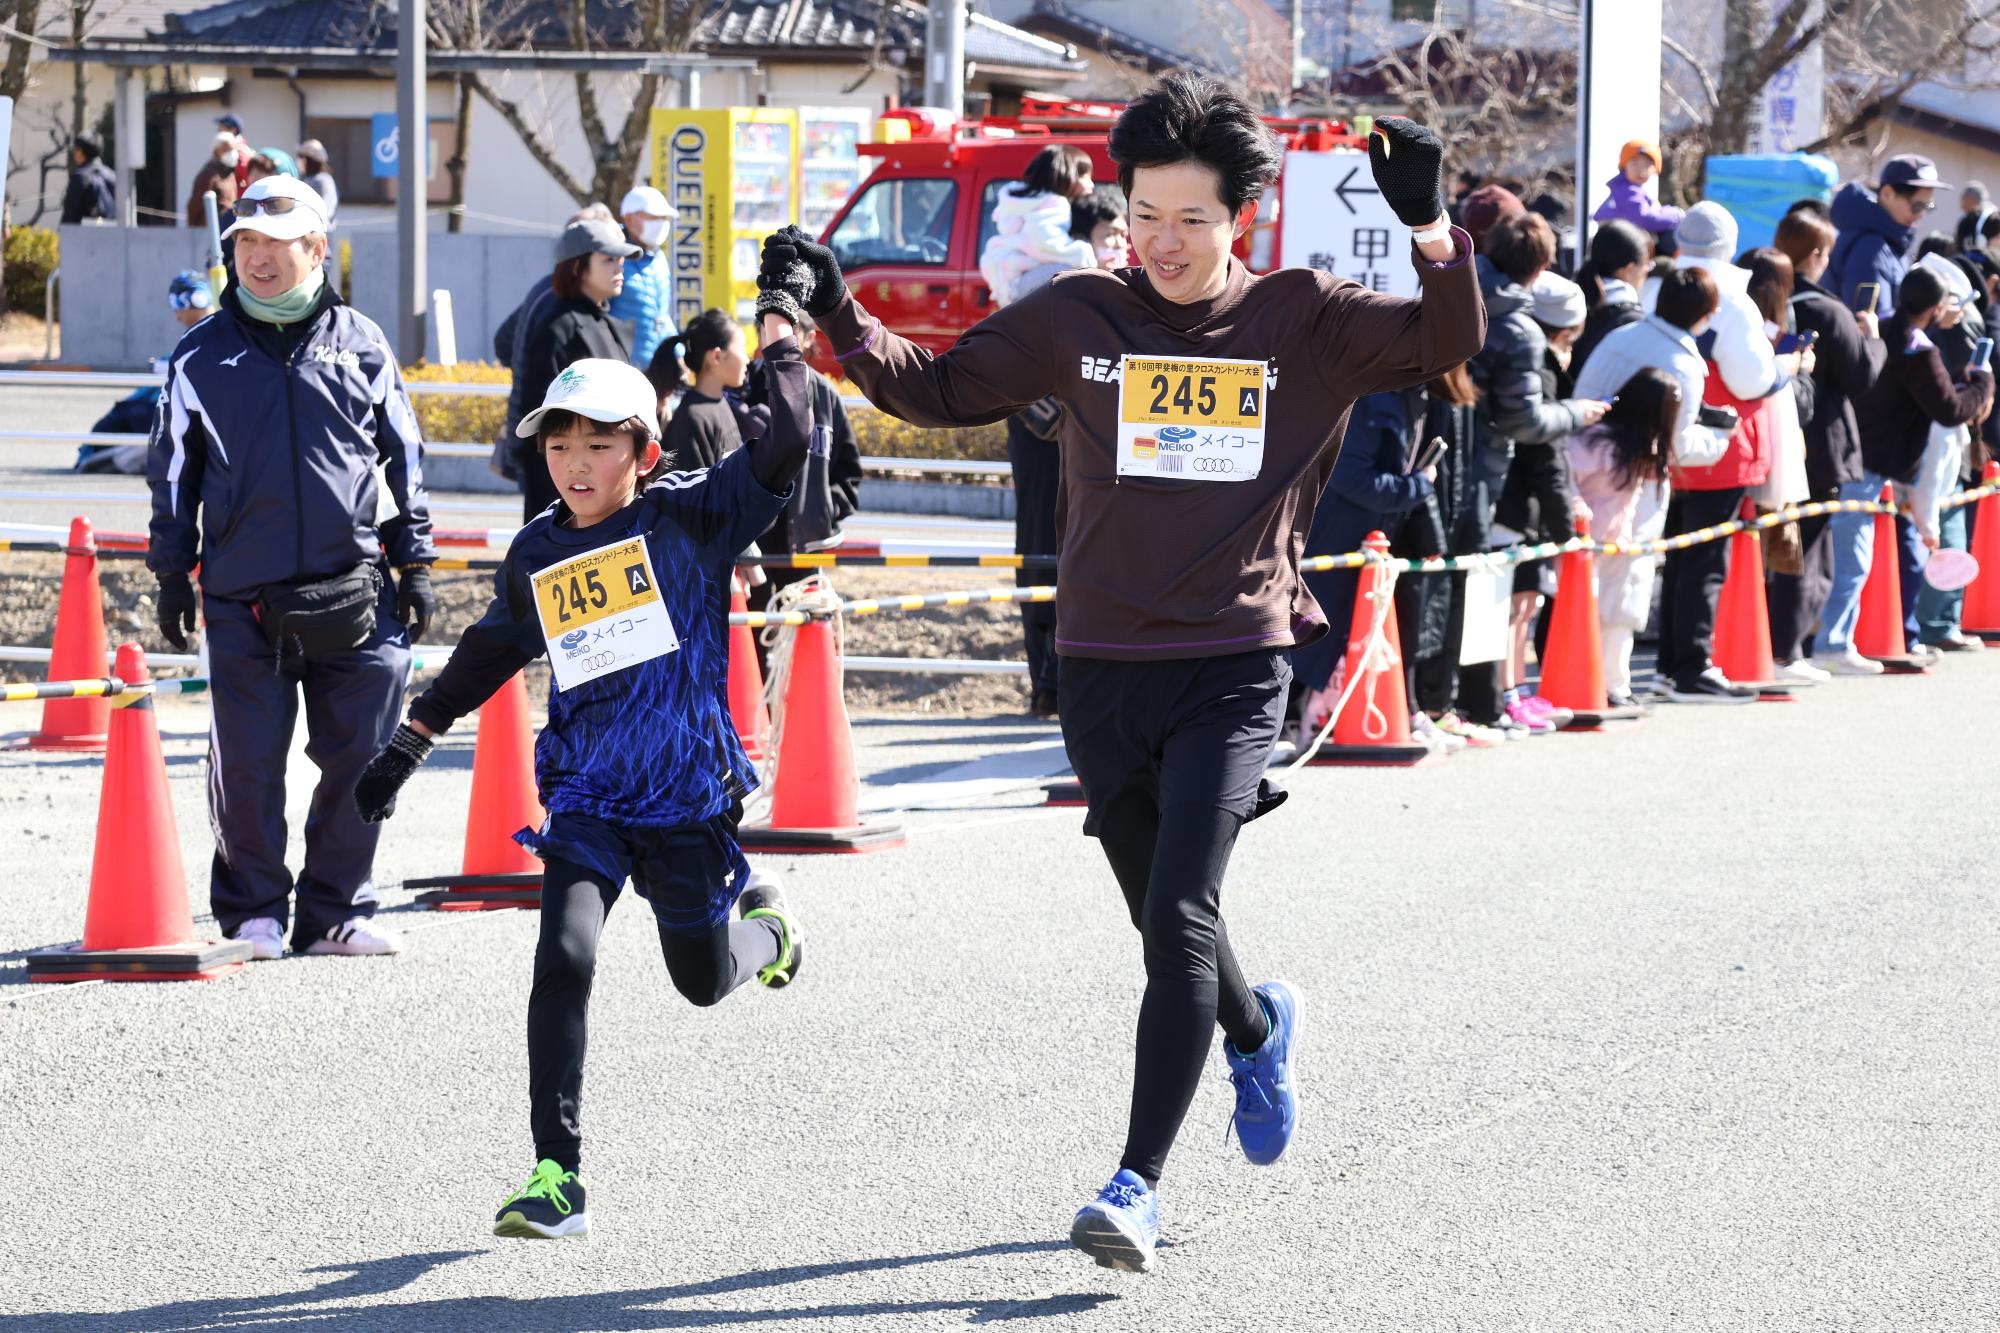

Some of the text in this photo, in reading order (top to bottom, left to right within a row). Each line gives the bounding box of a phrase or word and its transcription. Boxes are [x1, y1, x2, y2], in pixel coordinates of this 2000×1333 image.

[671, 125, 706, 332] QUEENBEE
[1149, 374, 1217, 415] 245
[1241, 392, 1257, 413] A
[1157, 441, 1194, 453] MEIKO
[1199, 433, 1260, 449] メイコー
[633, 570, 648, 591] A
[552, 569, 608, 623] 245
[593, 617, 649, 644] メイコー
[566, 645, 590, 660] MEIKO
